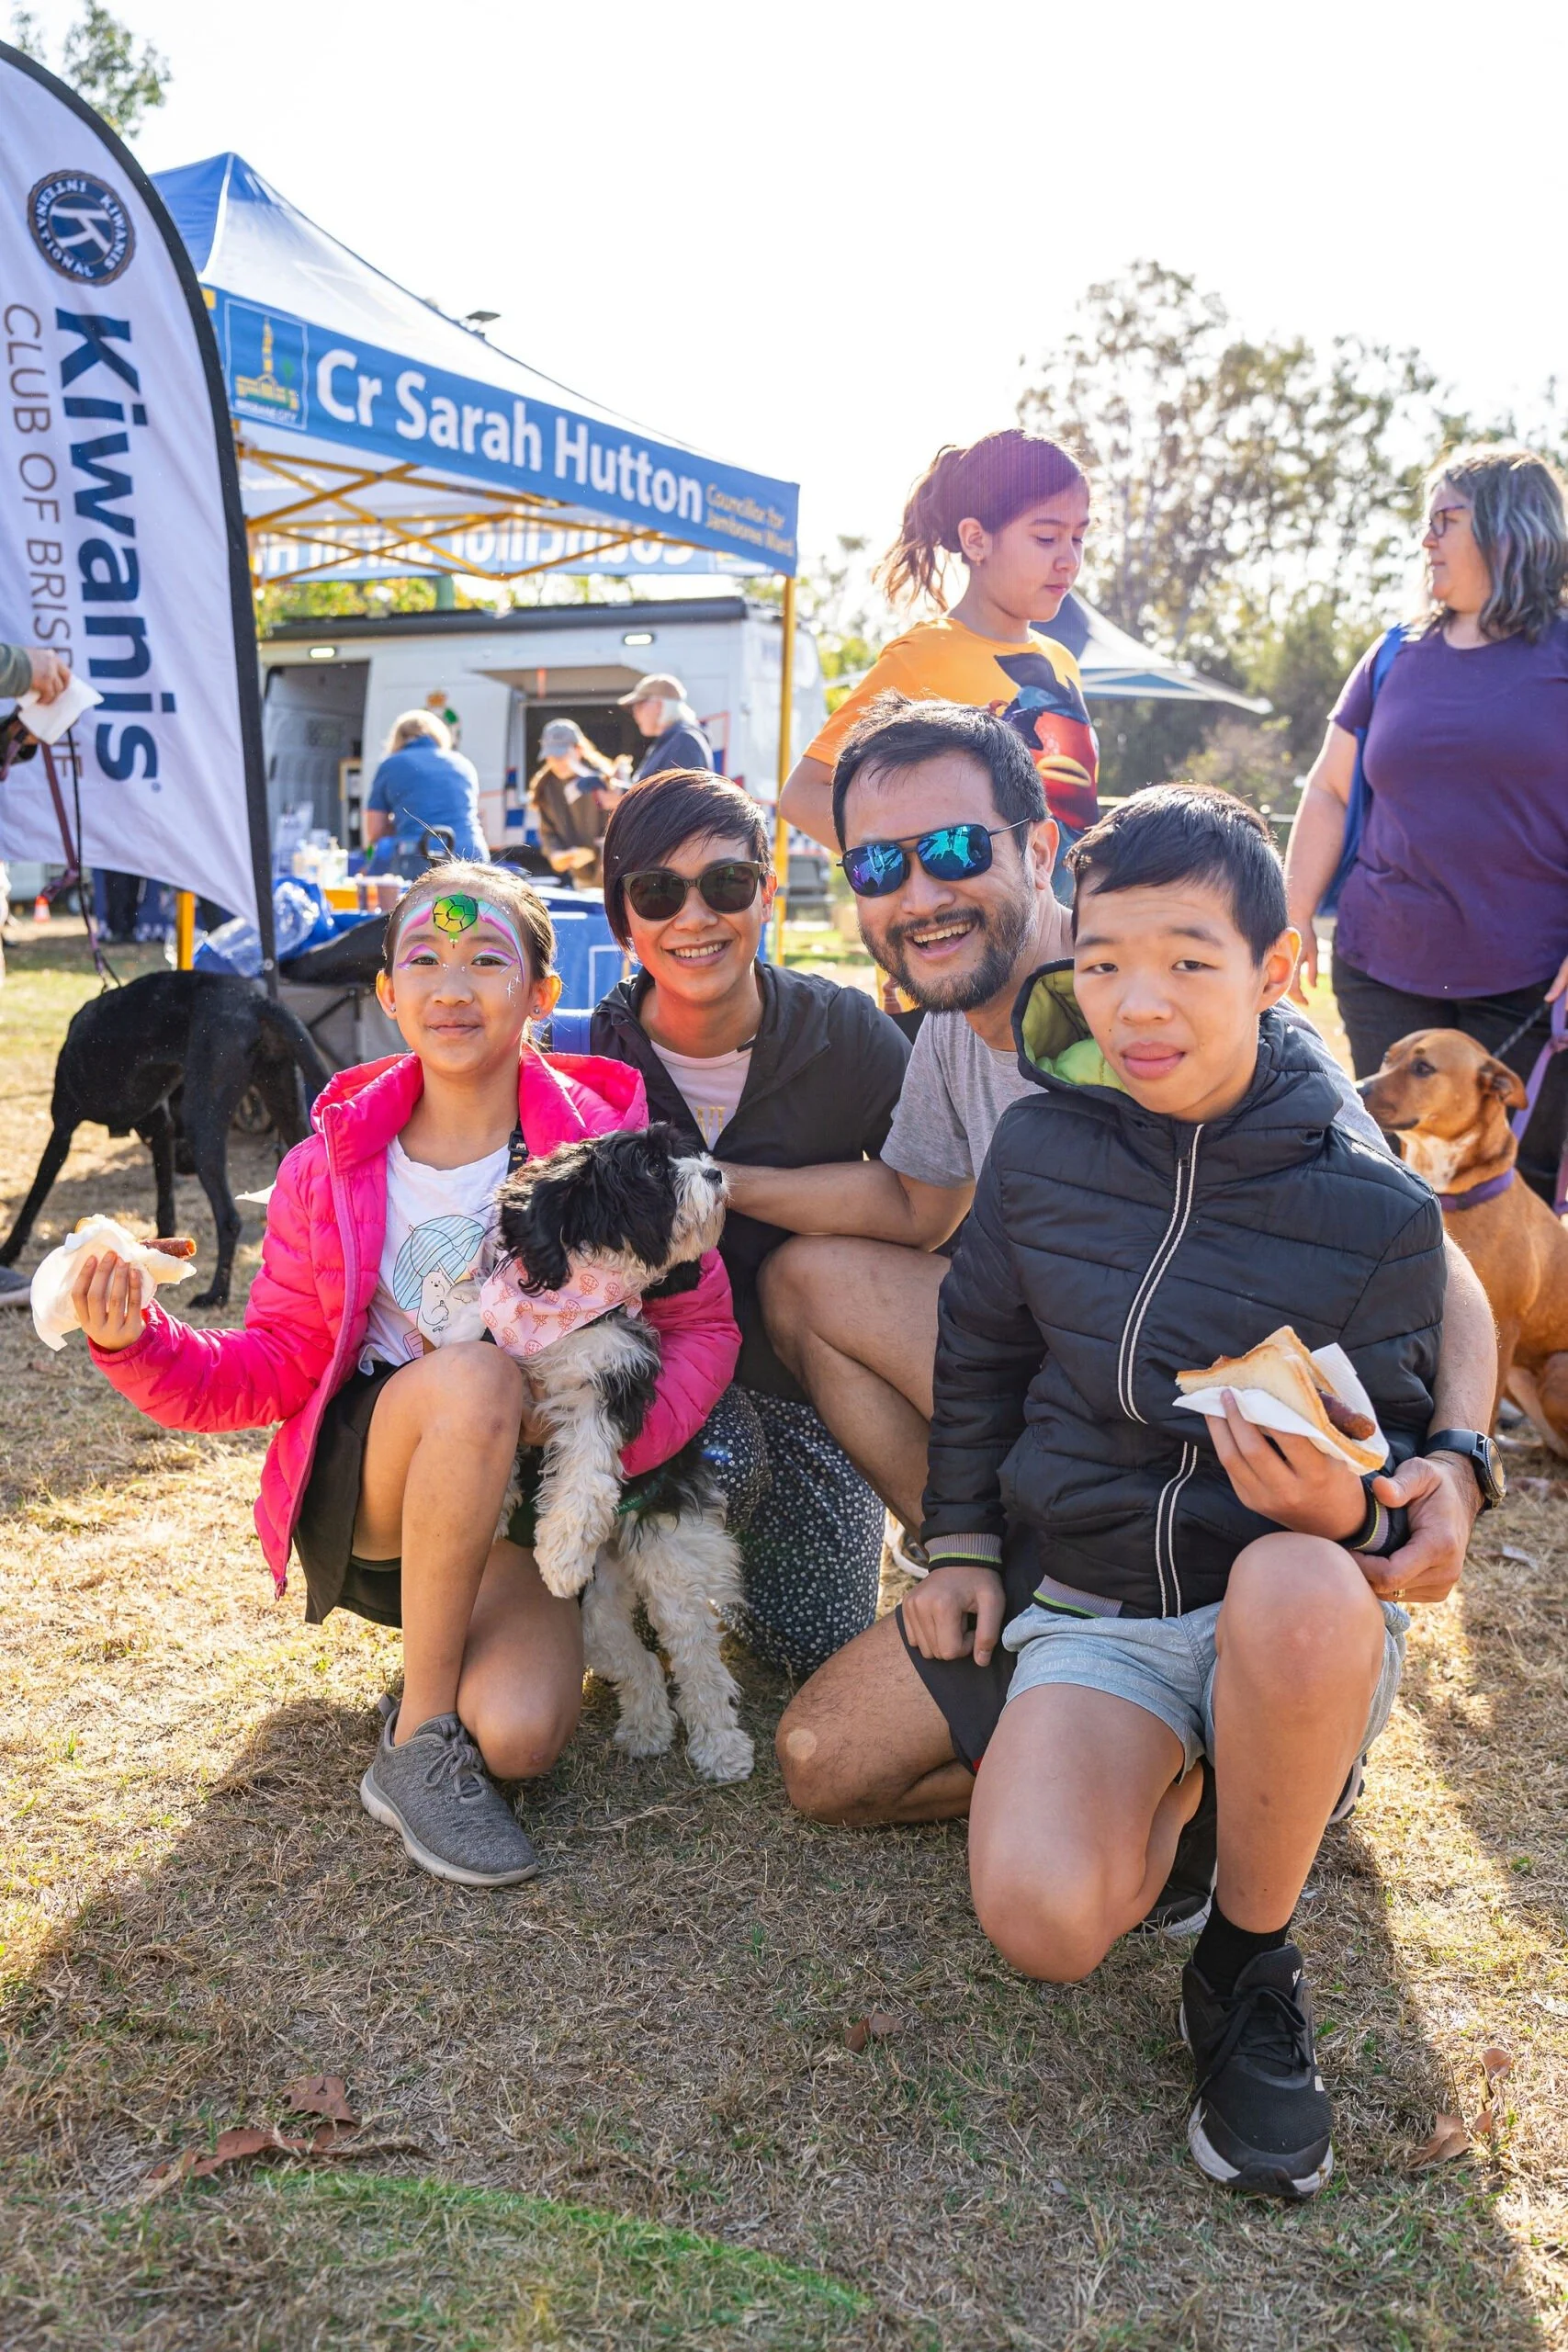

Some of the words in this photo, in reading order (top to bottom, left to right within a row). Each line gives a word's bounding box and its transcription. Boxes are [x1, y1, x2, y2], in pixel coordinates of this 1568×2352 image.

[36, 179, 95, 277] INTERNATIONAL
[99, 194, 128, 270] KIWANIS
[4, 304, 51, 435] CLUB
[22, 453, 61, 524] OF
[316, 348, 382, 427] Cr
[395, 369, 543, 472] Sarah
[554, 415, 704, 525] Hutton
[56, 307, 177, 783] Kiwanis
[27, 537, 84, 779] BRISE
